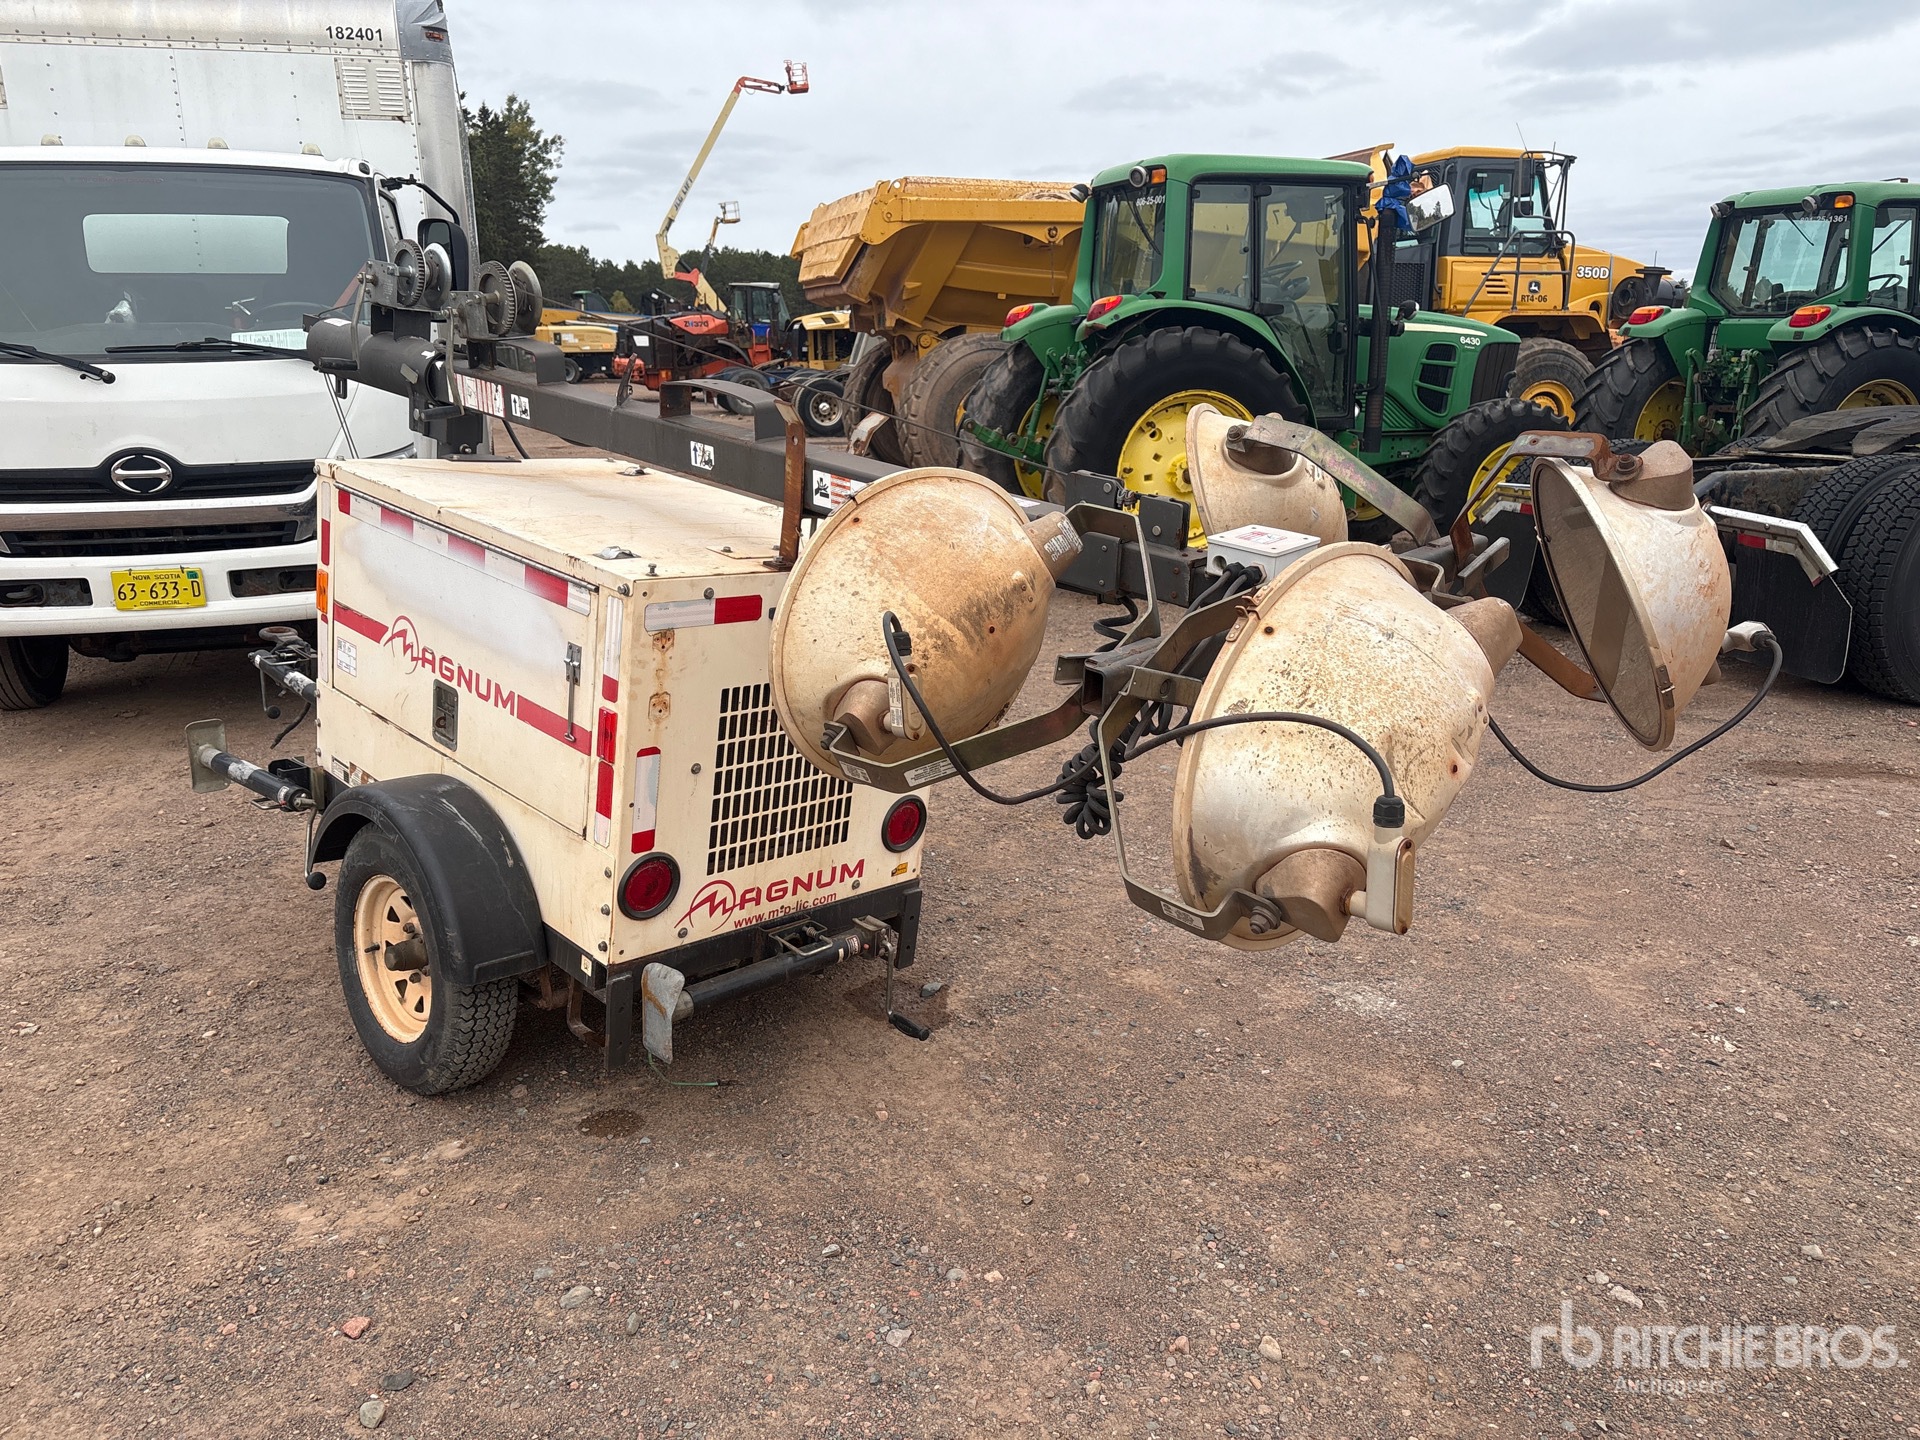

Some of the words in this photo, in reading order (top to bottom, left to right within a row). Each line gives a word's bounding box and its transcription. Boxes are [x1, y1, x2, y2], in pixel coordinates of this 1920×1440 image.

[325, 25, 383, 42] 182401
[681, 175, 693, 196] LIFT
[1576, 265, 1610, 280] 350D
[1459, 335, 1481, 346] 6430
[117, 580, 201, 601] 63-633-D
[383, 615, 516, 717] MAGNUM
[674, 858, 865, 932] MAGNUM
